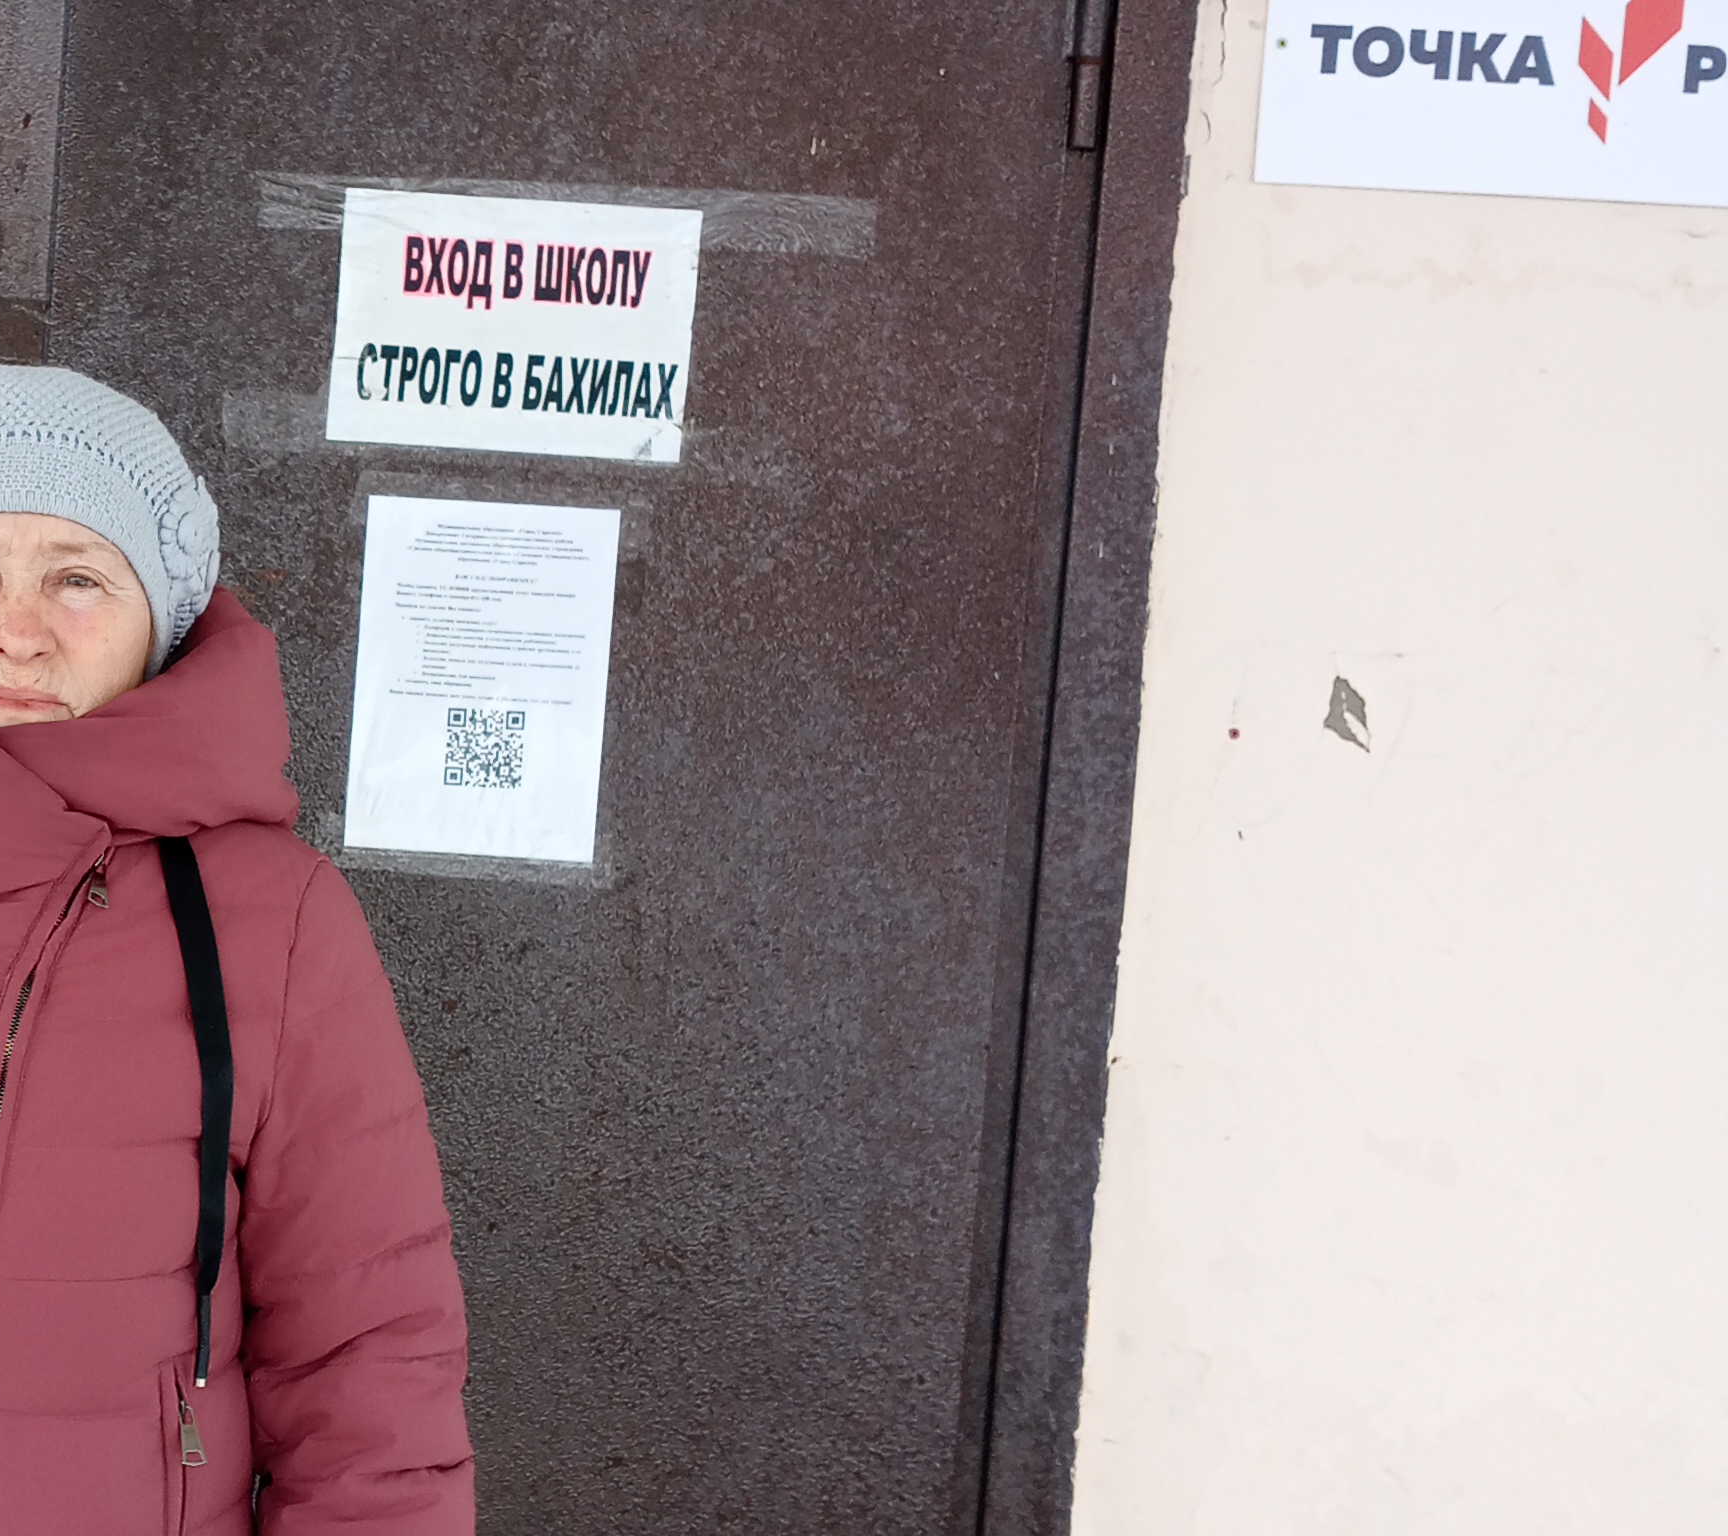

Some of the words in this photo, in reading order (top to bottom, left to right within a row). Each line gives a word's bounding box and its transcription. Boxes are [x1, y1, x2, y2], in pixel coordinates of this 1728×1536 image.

[1310, 23, 1556, 87] ТОЧКА
[403, 235, 494, 309] ВХОД
[502, 240, 524, 300] В
[533, 243, 653, 309] ШКОЛУ
[357, 342, 483, 407] СТРОГО
[491, 352, 514, 409] В
[522, 354, 679, 420] БАХИЛАХ
